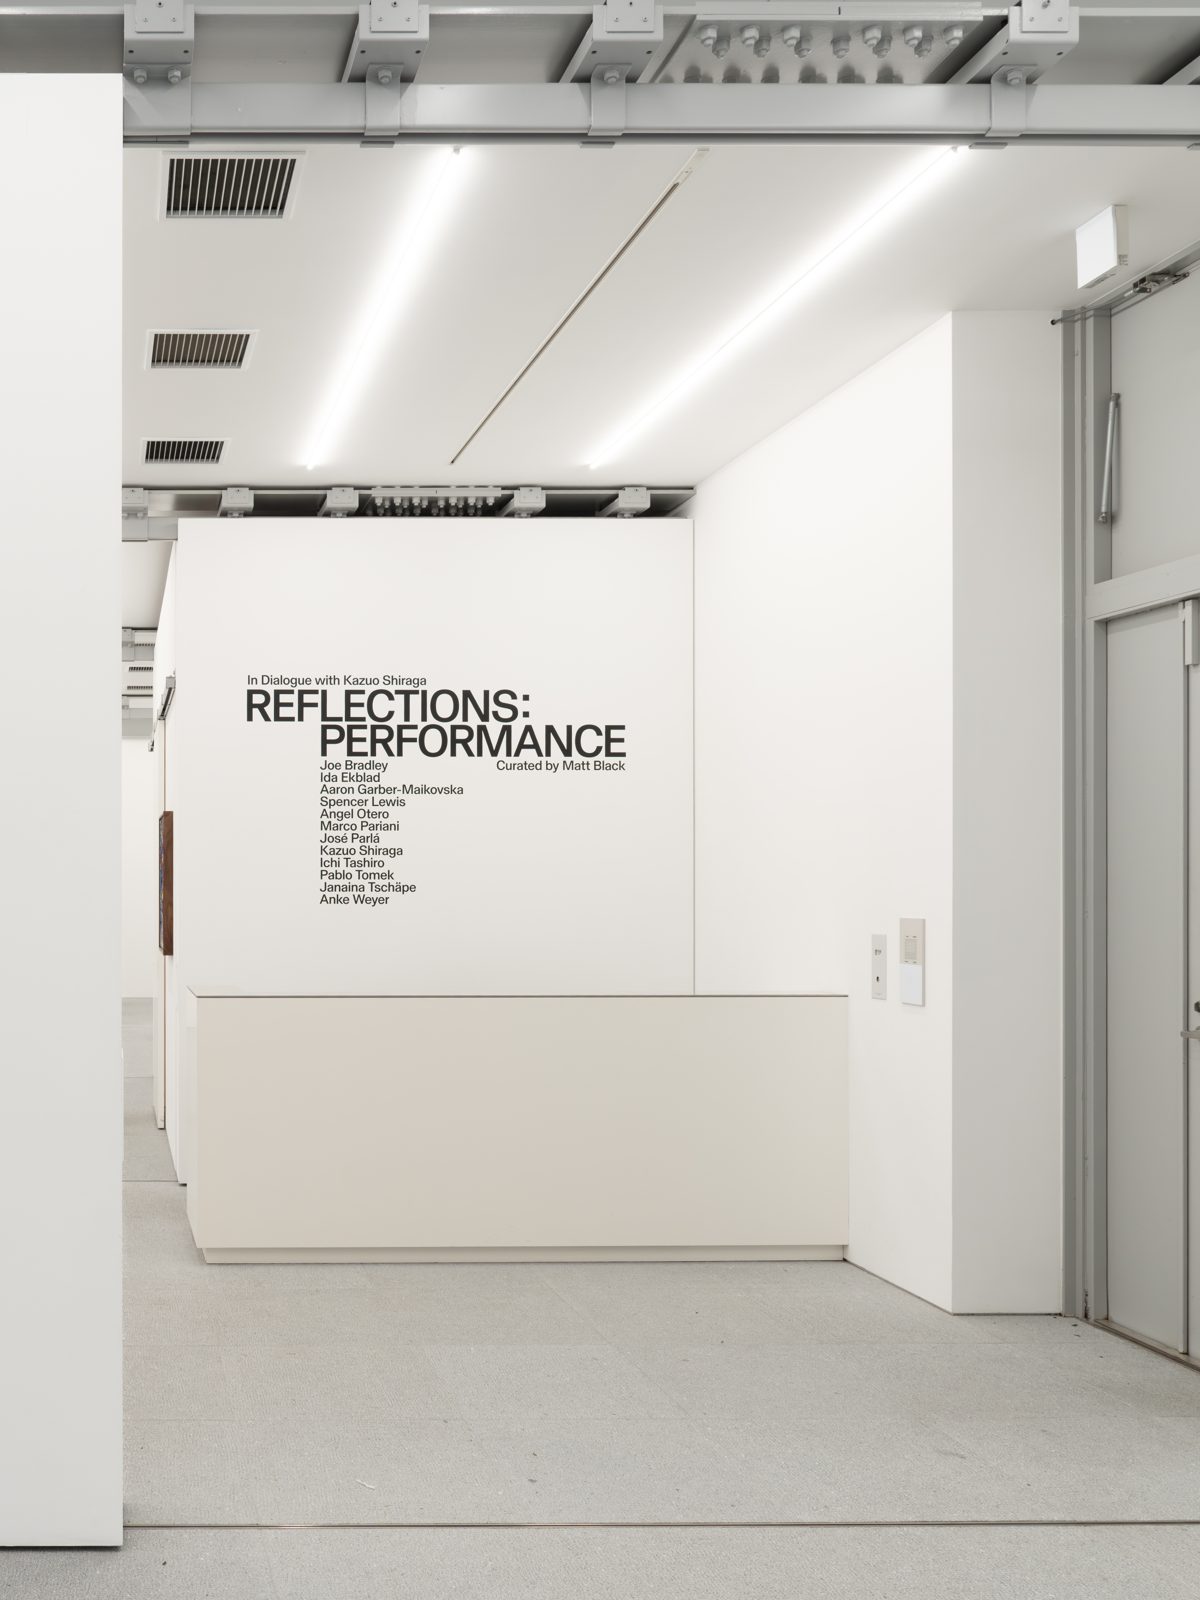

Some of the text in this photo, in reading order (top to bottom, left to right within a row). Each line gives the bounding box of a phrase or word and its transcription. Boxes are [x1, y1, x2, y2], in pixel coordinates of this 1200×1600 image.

[247, 674, 427, 688] In Dialogue with Kazuo Shiraga
[246, 688, 530, 723] REFLECTIONS:
[320, 723, 627, 758] PERFORMANCE
[319, 759, 389, 773] Joe Bradley
[496, 759, 626, 773] Curated by Matt Black
[320, 772, 381, 783] Ida Ekblad
[319, 783, 464, 795] Aaron Garber-Maikovska
[319, 796, 406, 810] Spencer Lewis
[319, 808, 390, 822] Angel Otero
[320, 820, 400, 832] Marco Pariani
[319, 832, 380, 844] José Parlá
[320, 844, 404, 859] Kazuo Shiraga
[319, 857, 385, 869] Ichi Tashiro
[319, 869, 395, 881] Pablo Tomek
[319, 881, 417, 895] Janaina Tschäpe
[319, 893, 390, 907] Anke Weyer
